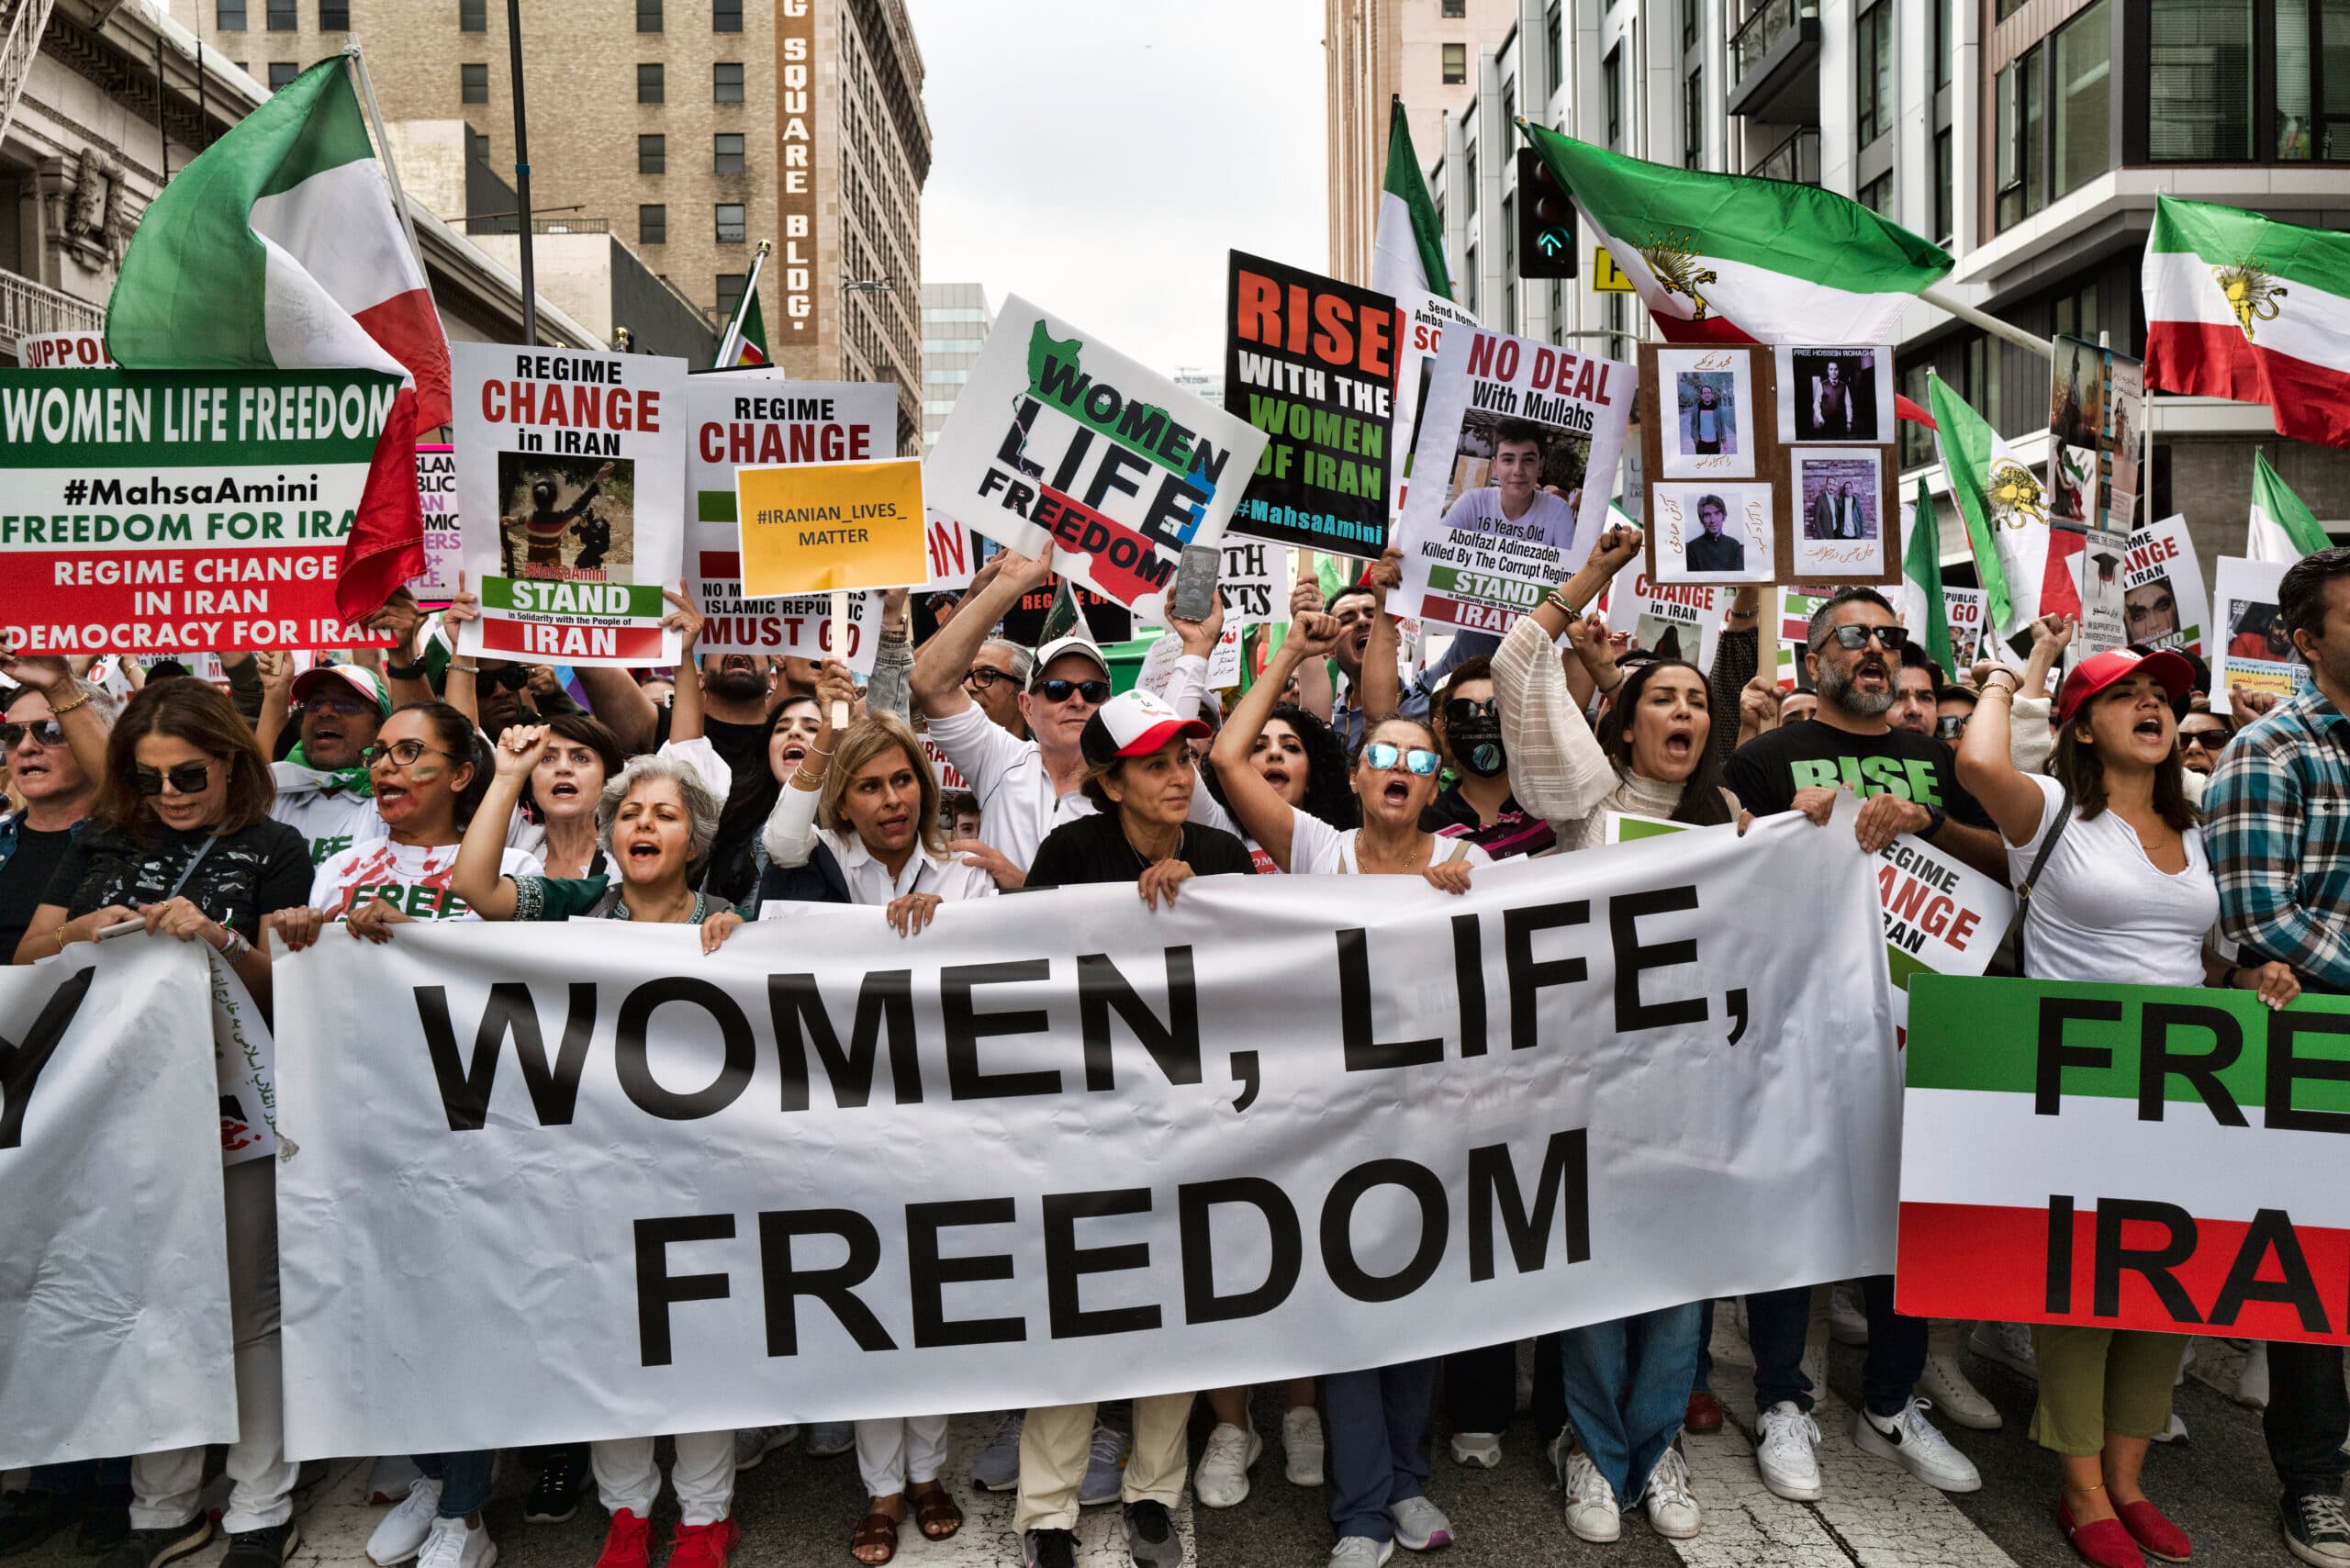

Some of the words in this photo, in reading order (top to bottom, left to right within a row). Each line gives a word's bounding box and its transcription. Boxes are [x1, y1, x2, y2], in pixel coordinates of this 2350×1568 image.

[782, 38, 810, 193] SQUARE
[787, 215, 811, 330] BLDG.
[1237, 270, 1390, 378] RISE
[1428, 300, 1452, 319] Send
[26, 337, 112, 368] SUPPO
[517, 354, 622, 384] REGIME
[1793, 349, 1812, 357] FREE
[1238, 350, 1326, 401] WITH
[1335, 376, 1390, 419] THE
[1467, 333, 1520, 383] NO
[1531, 347, 1612, 407] DEAL
[2, 387, 151, 443] WOMEN
[164, 386, 228, 442] LIFE
[239, 384, 397, 441] FREEDOM
[482, 379, 660, 432] CHANGE
[734, 397, 834, 420] REGIME
[1039, 354, 1230, 486] WOMEN
[1472, 380, 1516, 415] With
[1523, 390, 1595, 431] Mullahs
[518, 428, 543, 452] in
[554, 431, 621, 456] IRAN
[699, 421, 871, 464] CHANGE
[1249, 393, 1382, 459] WOMEN
[997, 397, 1209, 553] LIFE
[1255, 444, 1292, 479] OF
[1304, 450, 1382, 501] IRAN
[63, 474, 319, 506] #MahsaAmini
[2, 513, 192, 543] FREEDOM
[207, 511, 284, 541] FOR
[297, 510, 356, 538] IRA
[757, 502, 907, 525] #IRANIAN_LIVES_
[978, 467, 1174, 588] FREEDOM
[1234, 499, 1382, 545] #MahsaAmini
[1477, 516, 1491, 532] 16
[1494, 519, 1524, 538] Years
[1527, 524, 1545, 542] Old
[799, 528, 868, 546] MATTER
[1449, 529, 1497, 551] Abolfazl
[1497, 538, 1561, 563] Adinezadeh
[54, 559, 184, 586] REGIME
[194, 555, 337, 583] CHANGE
[524, 562, 607, 582] #MahsaAmini
[1223, 543, 1268, 578] TH
[1421, 541, 1456, 561] Killed
[1457, 548, 1472, 567] By
[1476, 551, 1496, 569] The
[1498, 556, 1541, 581] Corrupt
[2131, 564, 2165, 586] IRAN
[134, 592, 174, 615] IN
[184, 589, 268, 613] IRAN
[512, 580, 631, 614] STAND
[702, 583, 722, 597] NO
[1022, 590, 1086, 610] REGE
[1453, 571, 1539, 606] STAND
[1454, 593, 1483, 606] Solidarity
[1484, 599, 1497, 608] with
[1498, 601, 1508, 610] the
[1509, 604, 1529, 614] People
[1634, 573, 1715, 610] CHANGE
[509, 610, 515, 619] in
[517, 611, 554, 624] Solidarity
[556, 614, 574, 624] with
[576, 616, 590, 624] the
[592, 617, 621, 626] People
[705, 599, 775, 614] ISLAMIC
[783, 600, 863, 622] REPUIC
[1650, 600, 1663, 616] in
[1668, 604, 1697, 622] IRAN
[1953, 604, 1978, 623] GO
[7, 622, 221, 650] DEMOCRACY
[233, 620, 298, 646] FOR
[309, 619, 392, 644] IRAN
[523, 624, 616, 655] IRAN
[702, 617, 804, 647] MUST
[2146, 631, 2185, 650] AND
[1790, 756, 1943, 807] RISE
[1879, 840, 1960, 895] EGIME
[347, 883, 468, 919] FREE
[412, 946, 1260, 1131] WOMEN,
[1337, 884, 1749, 1072] LIFE,
[632, 1127, 1591, 1367] FREEDOM
[2044, 1193, 2350, 1334] IRA
